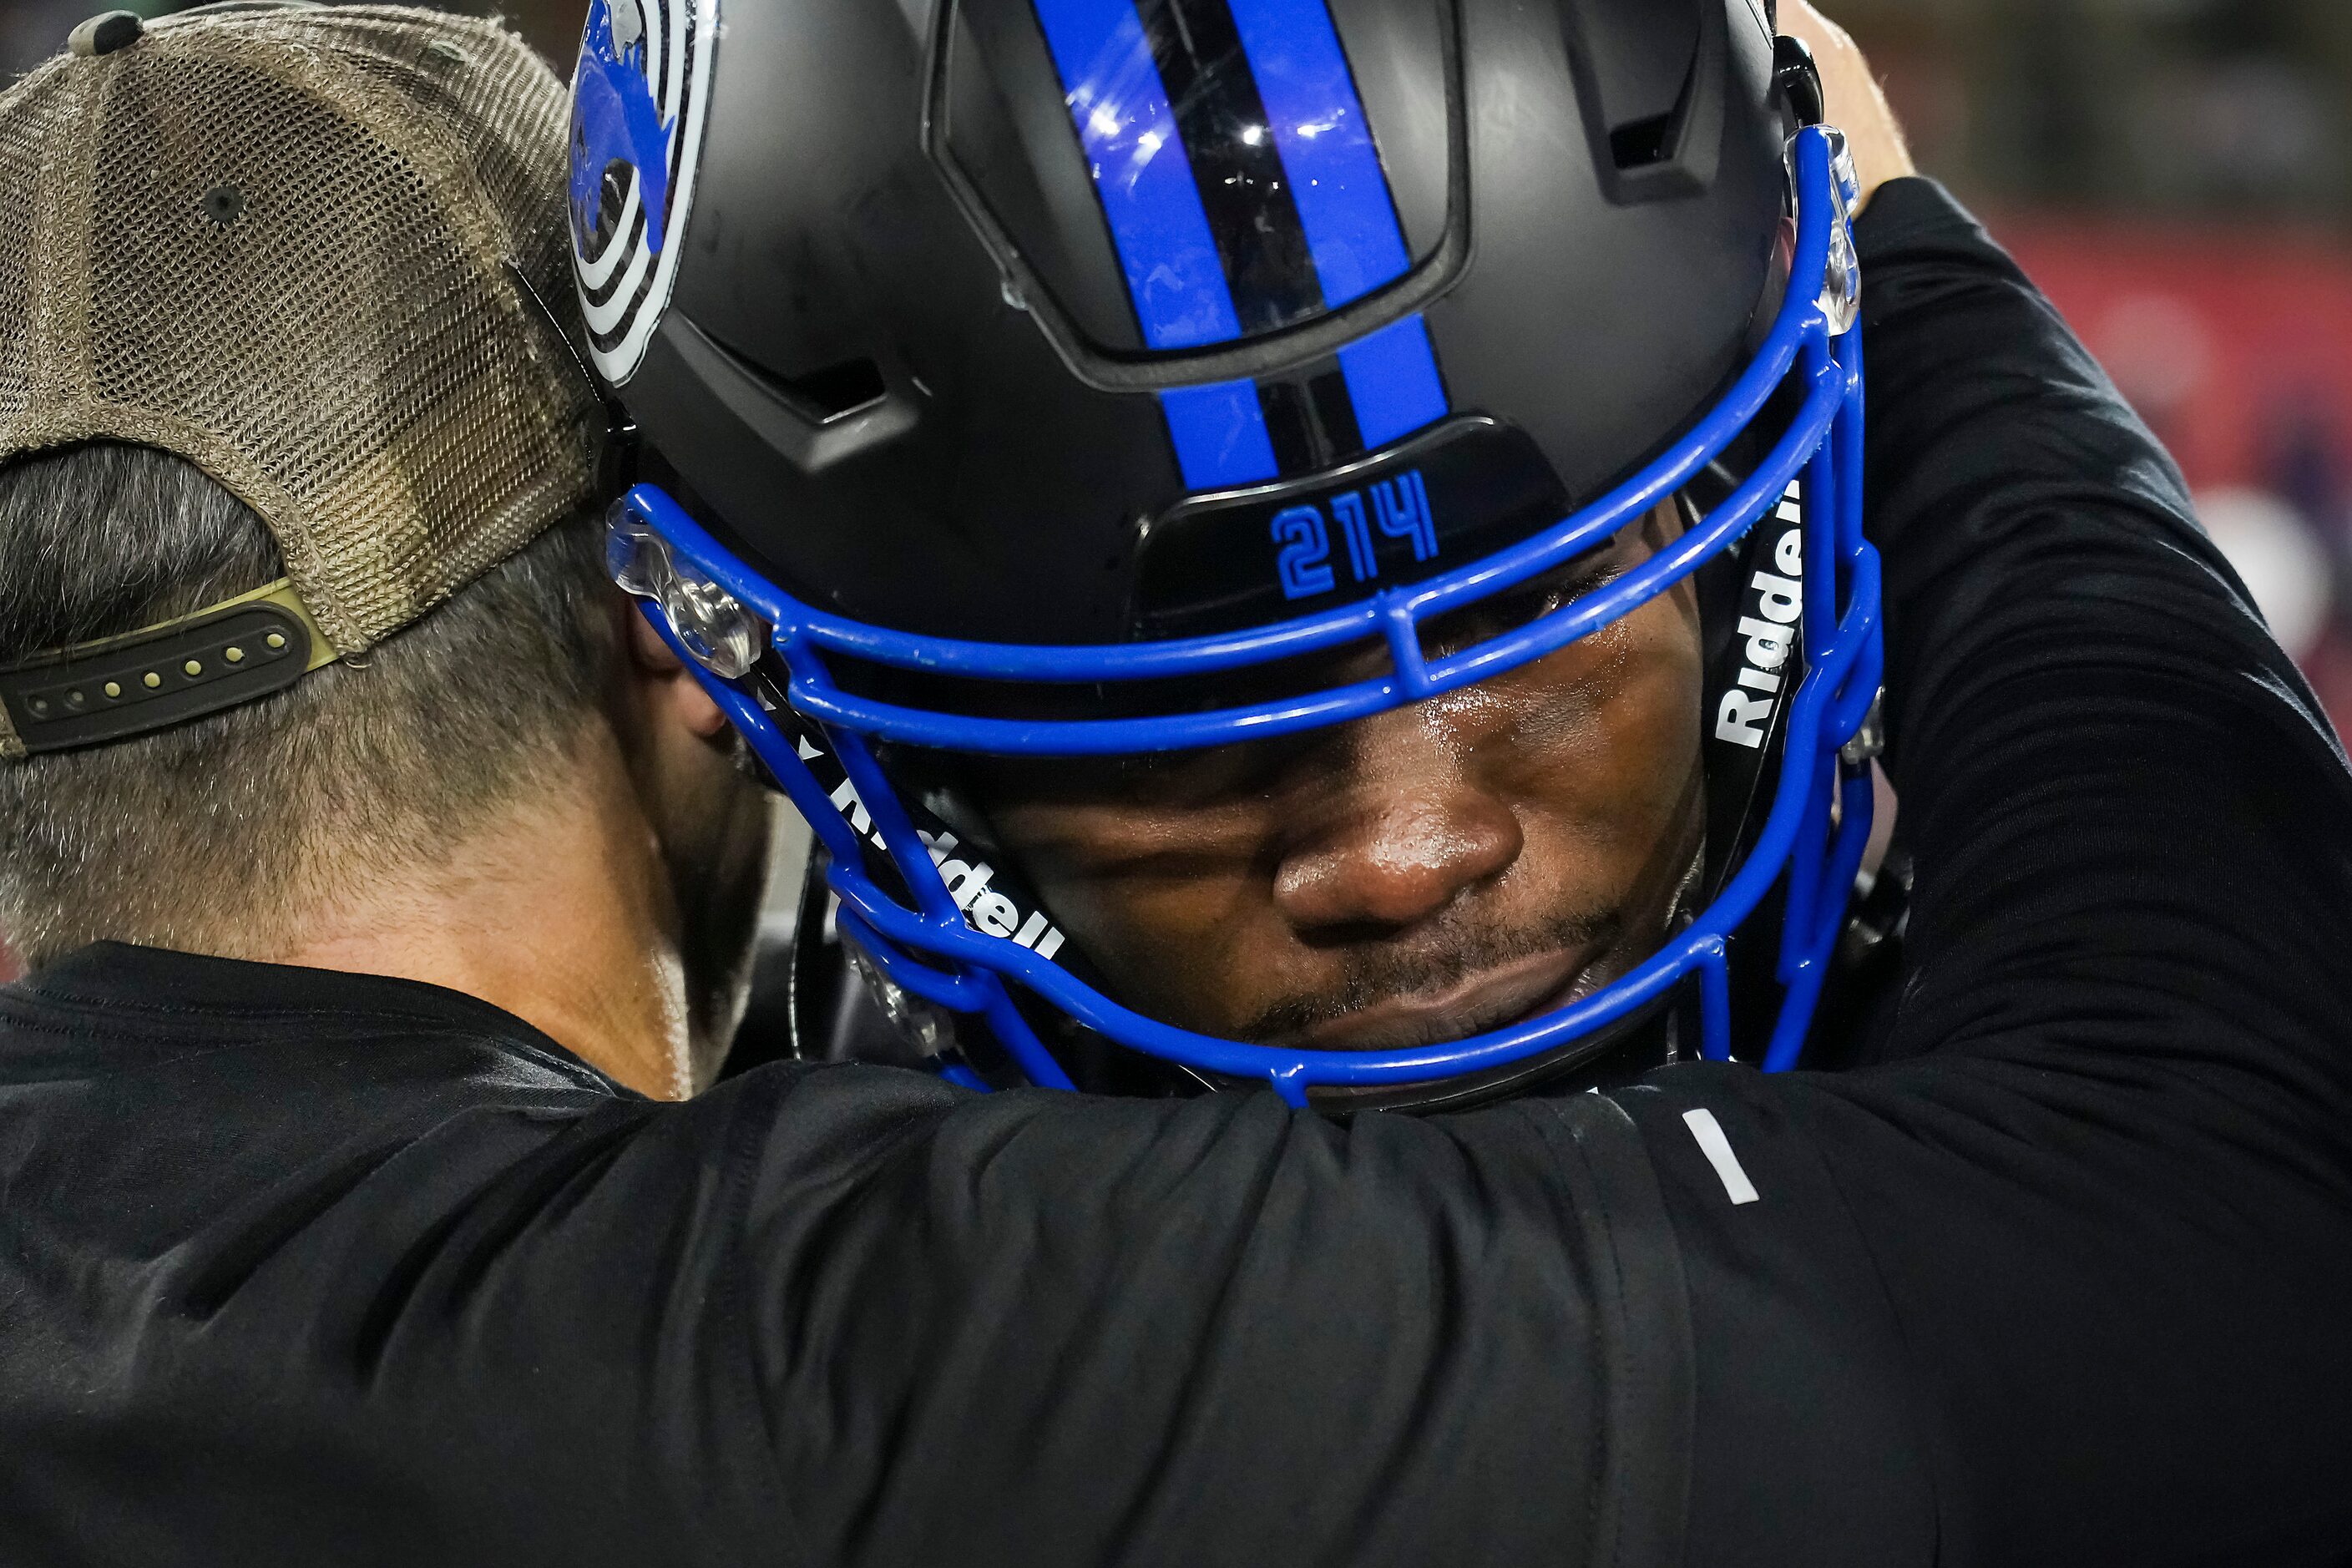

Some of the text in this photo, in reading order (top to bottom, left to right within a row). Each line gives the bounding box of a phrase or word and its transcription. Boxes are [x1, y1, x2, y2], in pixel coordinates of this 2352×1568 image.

[1270, 468, 1439, 601] 214
[1715, 479, 1803, 748] Ridde
[830, 777, 1065, 960] dell
